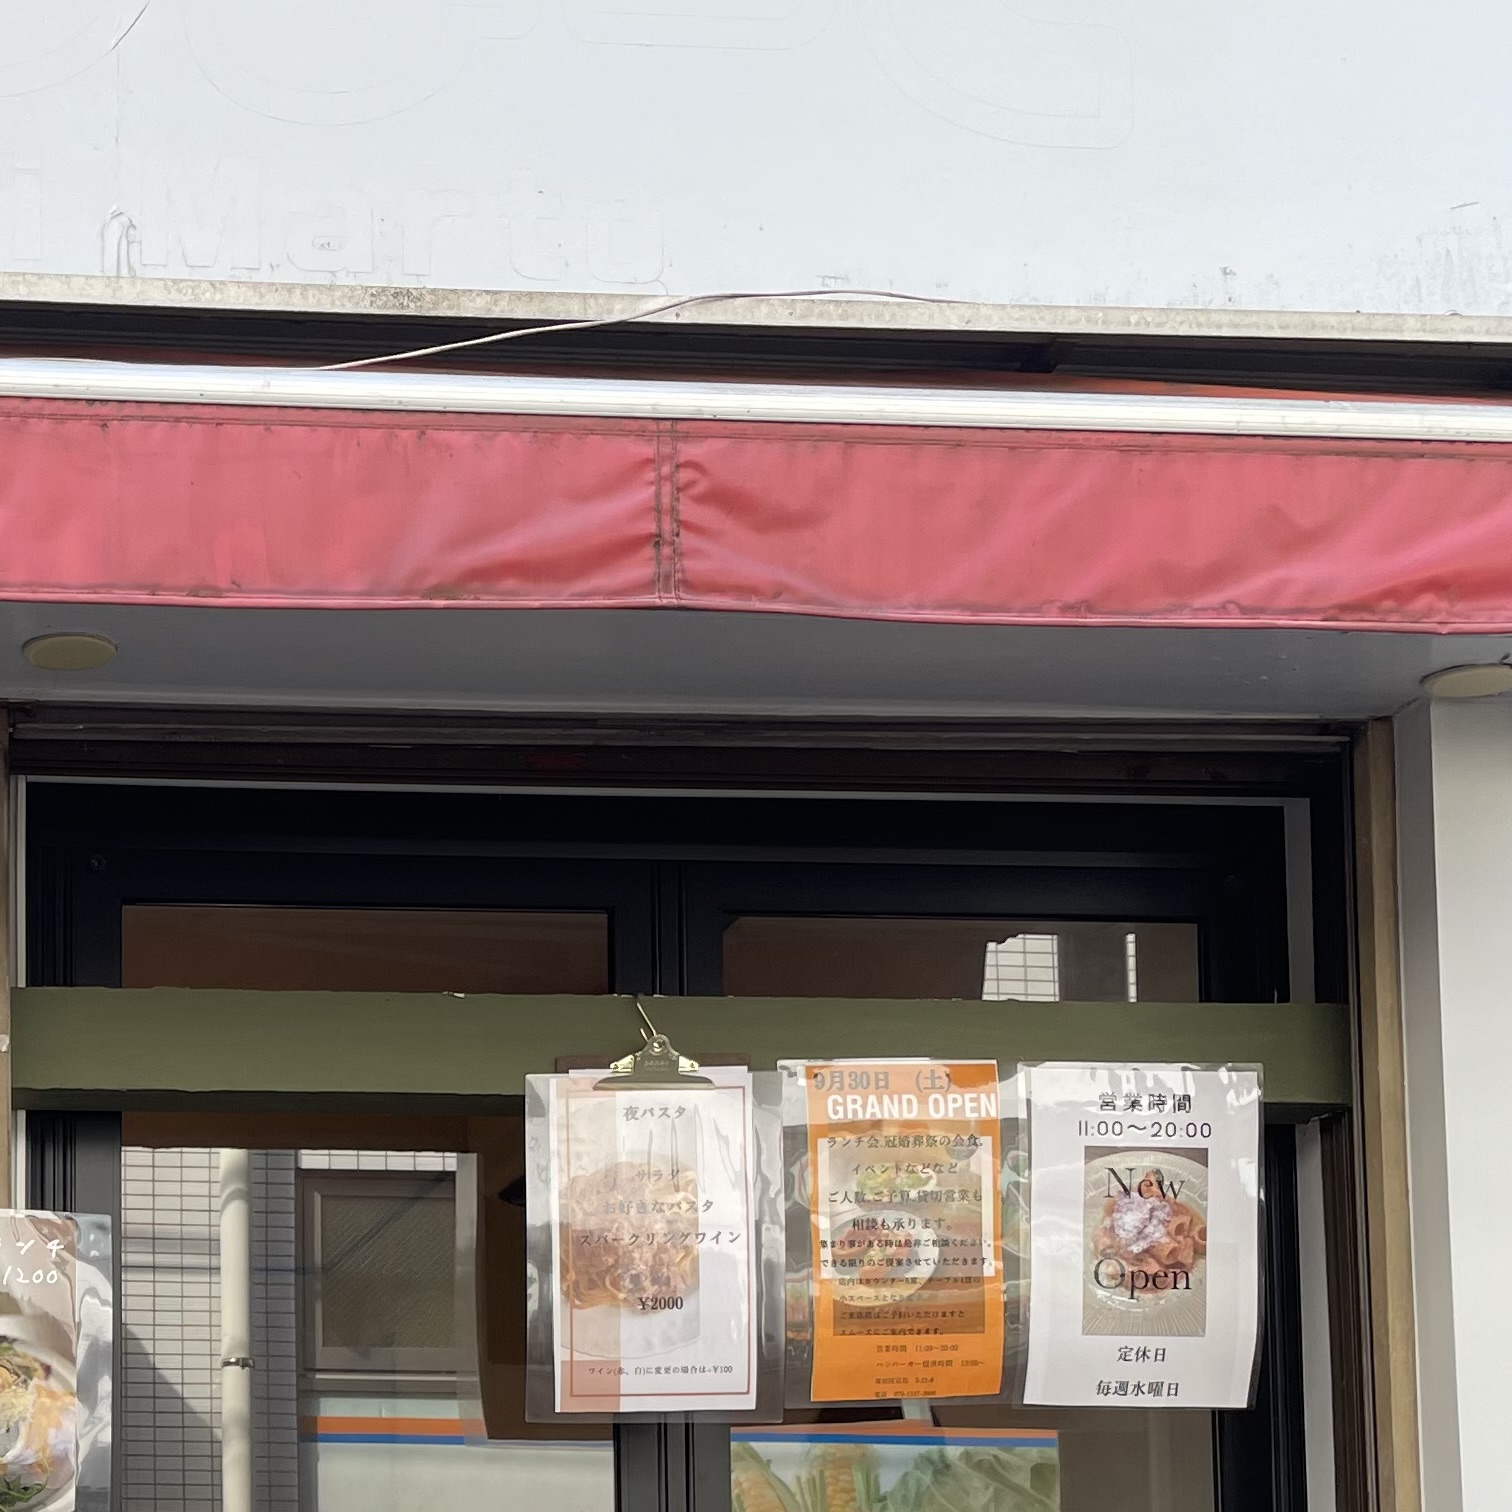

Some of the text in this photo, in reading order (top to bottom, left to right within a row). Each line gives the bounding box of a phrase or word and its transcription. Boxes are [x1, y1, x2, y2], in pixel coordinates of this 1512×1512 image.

[826, 1093, 998, 1121] GRAND OPEN
[1098, 1092, 1192, 1115] 営業時間
[622, 1105, 687, 1123] 夜パスタ
[1103, 1166, 1185, 1201] New
[578, 1230, 743, 1247] スパークリングワイン
[1092, 1256, 1193, 1300] Open
[637, 1295, 684, 1312] ¥2000
[1116, 1346, 1167, 1363] 定休日
[1095, 1379, 1181, 1398] 毎週水曜日
